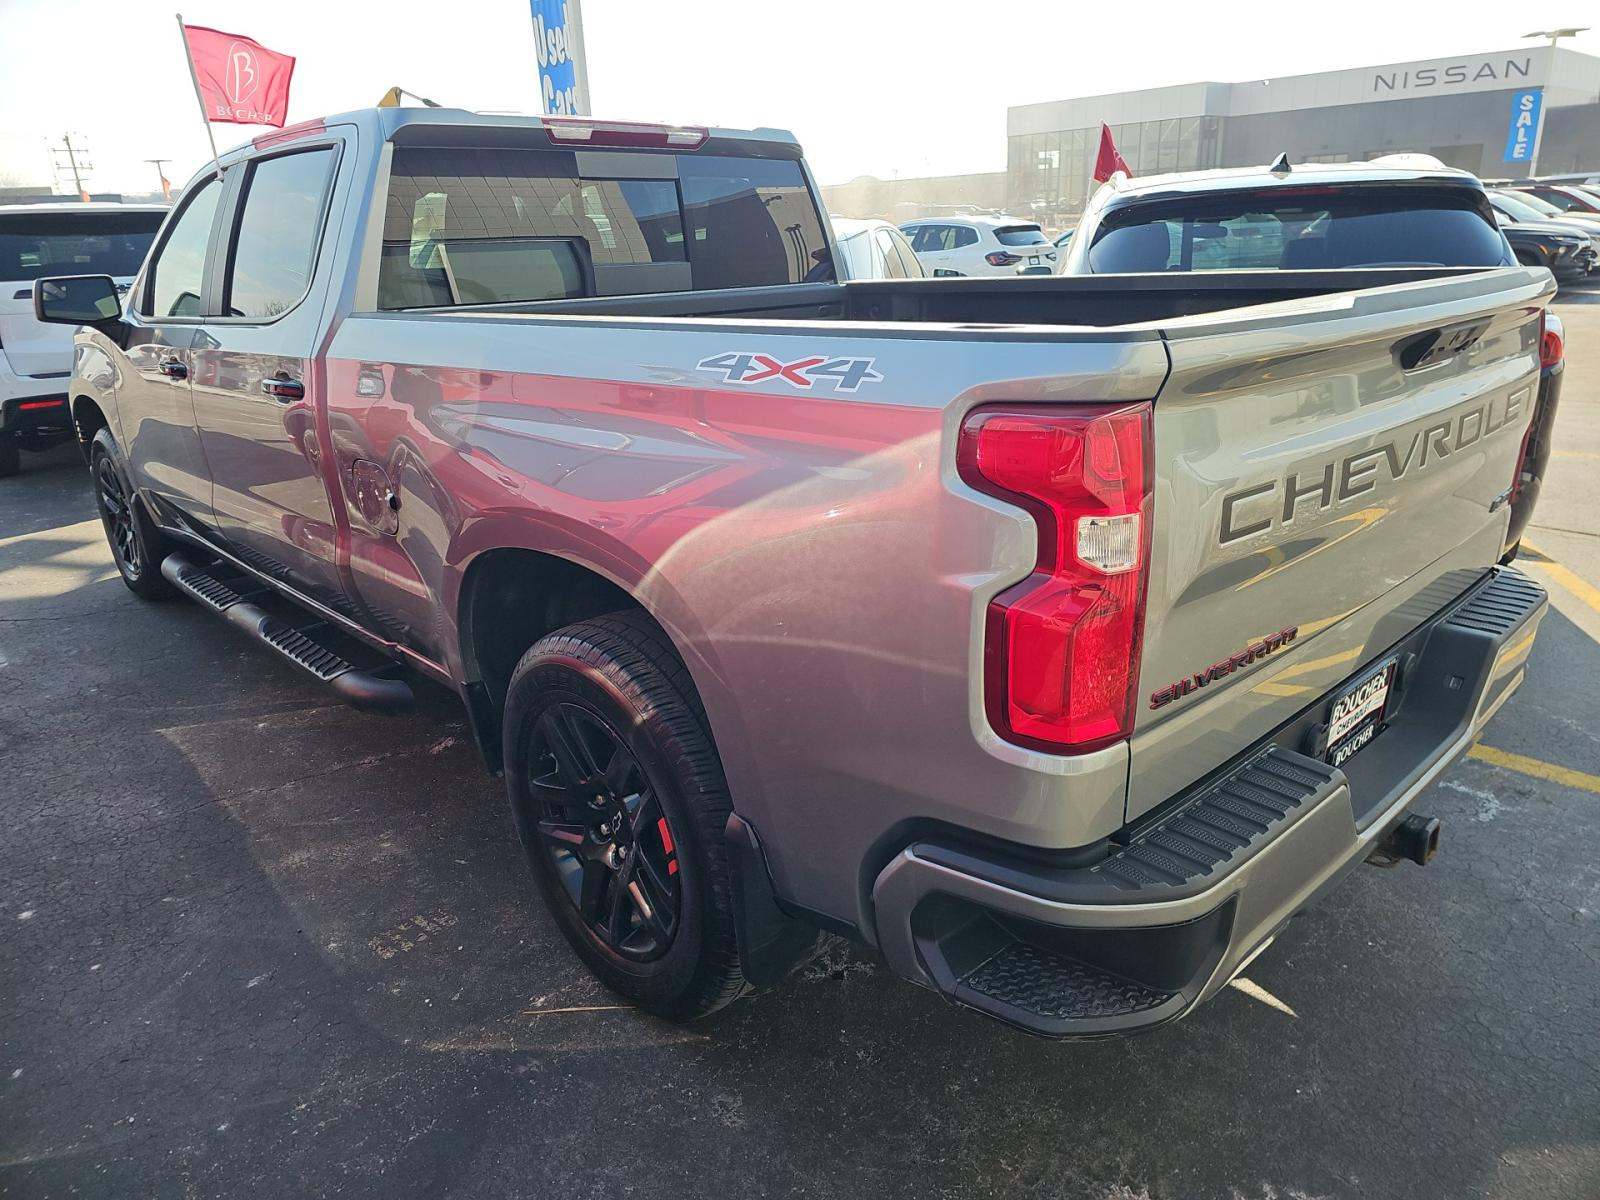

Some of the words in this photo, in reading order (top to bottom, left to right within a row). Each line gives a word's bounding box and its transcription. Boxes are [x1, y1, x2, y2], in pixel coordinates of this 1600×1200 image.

[1374, 58, 1531, 91] NISSAN
[1512, 94, 1534, 159] SALE
[1218, 381, 1537, 549] CHEVROLET
[1150, 625, 1299, 710] SILVERADO
[1332, 667, 1389, 726] BOUCHER
[1335, 724, 1375, 767] BOUCHER
